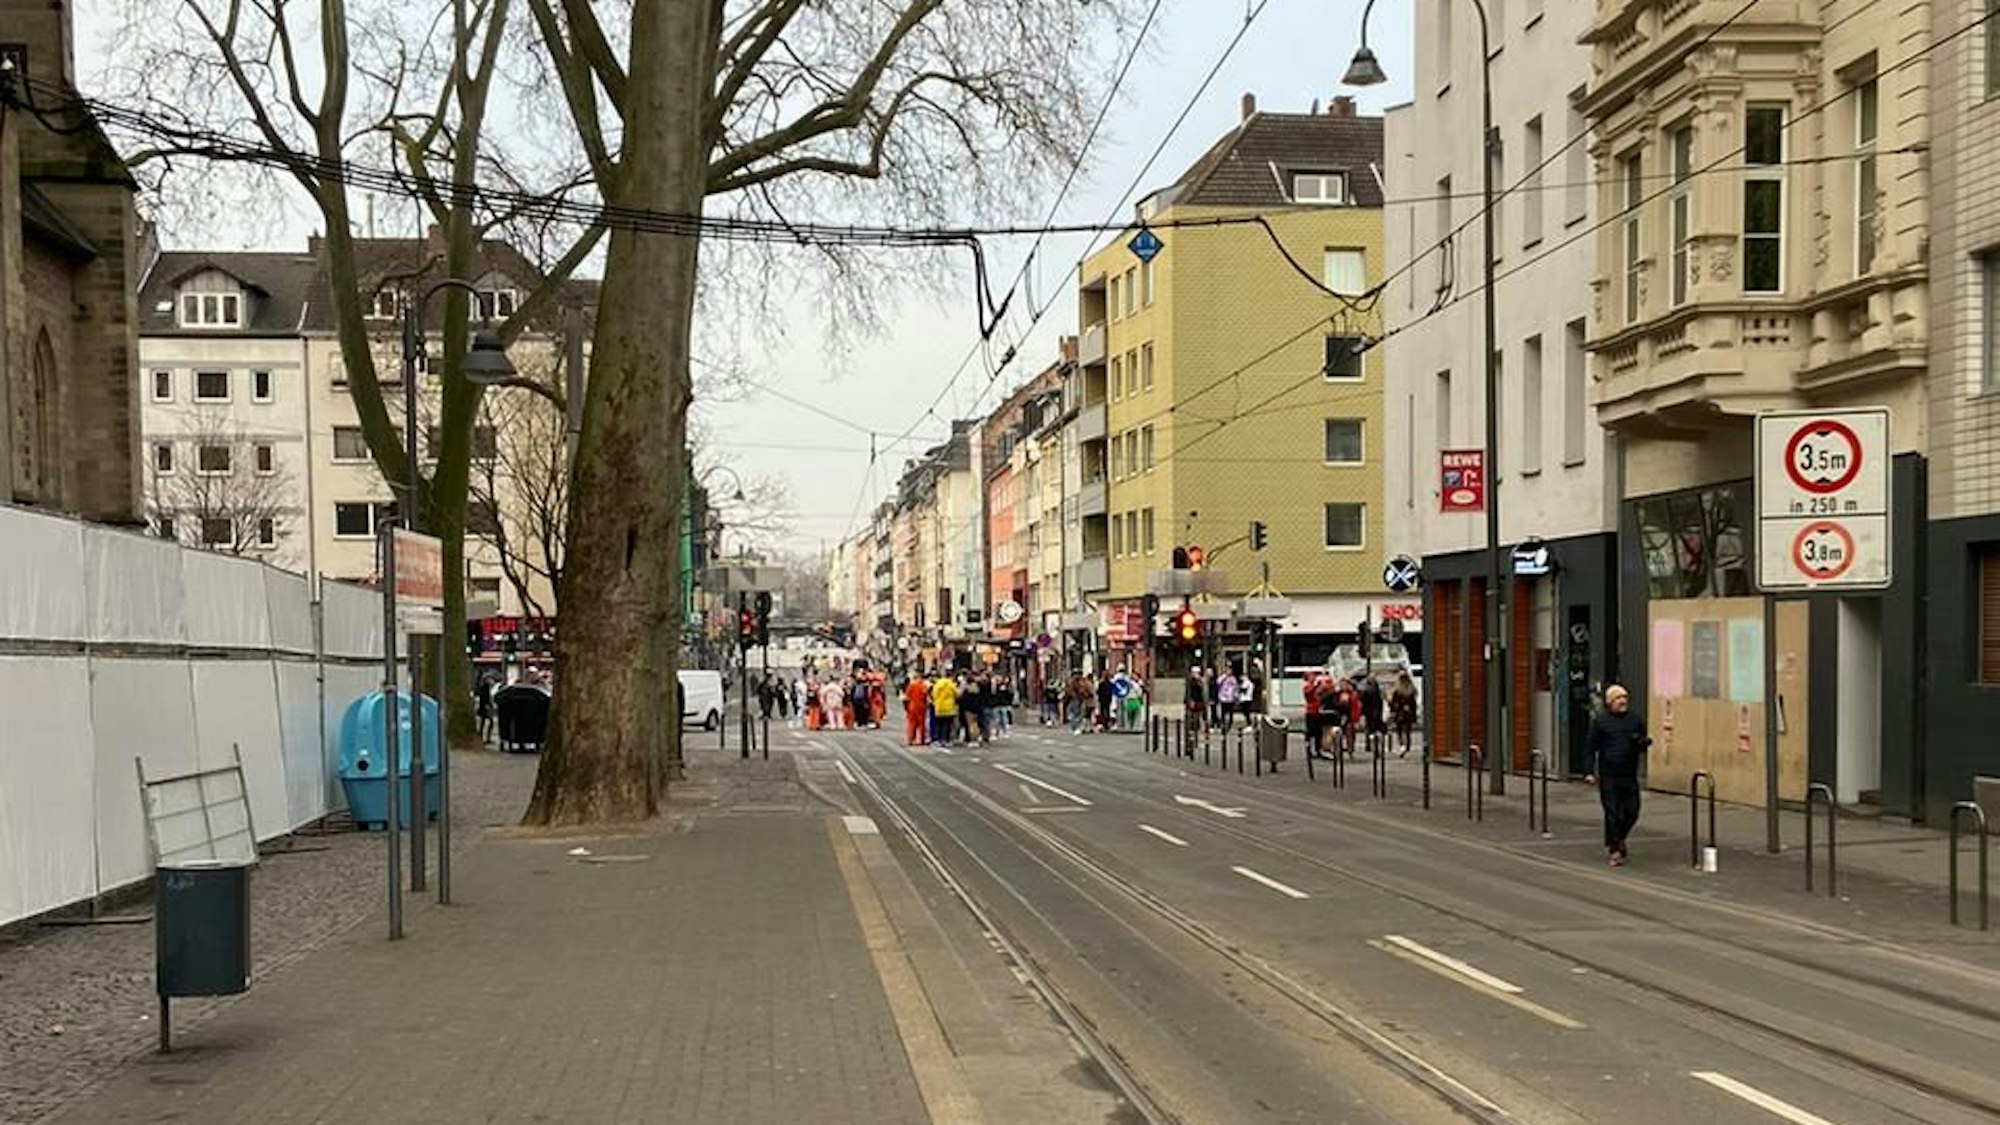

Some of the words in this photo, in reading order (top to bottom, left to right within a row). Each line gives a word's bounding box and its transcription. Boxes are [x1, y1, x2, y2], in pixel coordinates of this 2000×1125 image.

[1442, 453, 1482, 467] REWE
[1789, 498, 1803, 513] in
[1810, 497, 1837, 513] 250
[1844, 499, 1857, 511] m
